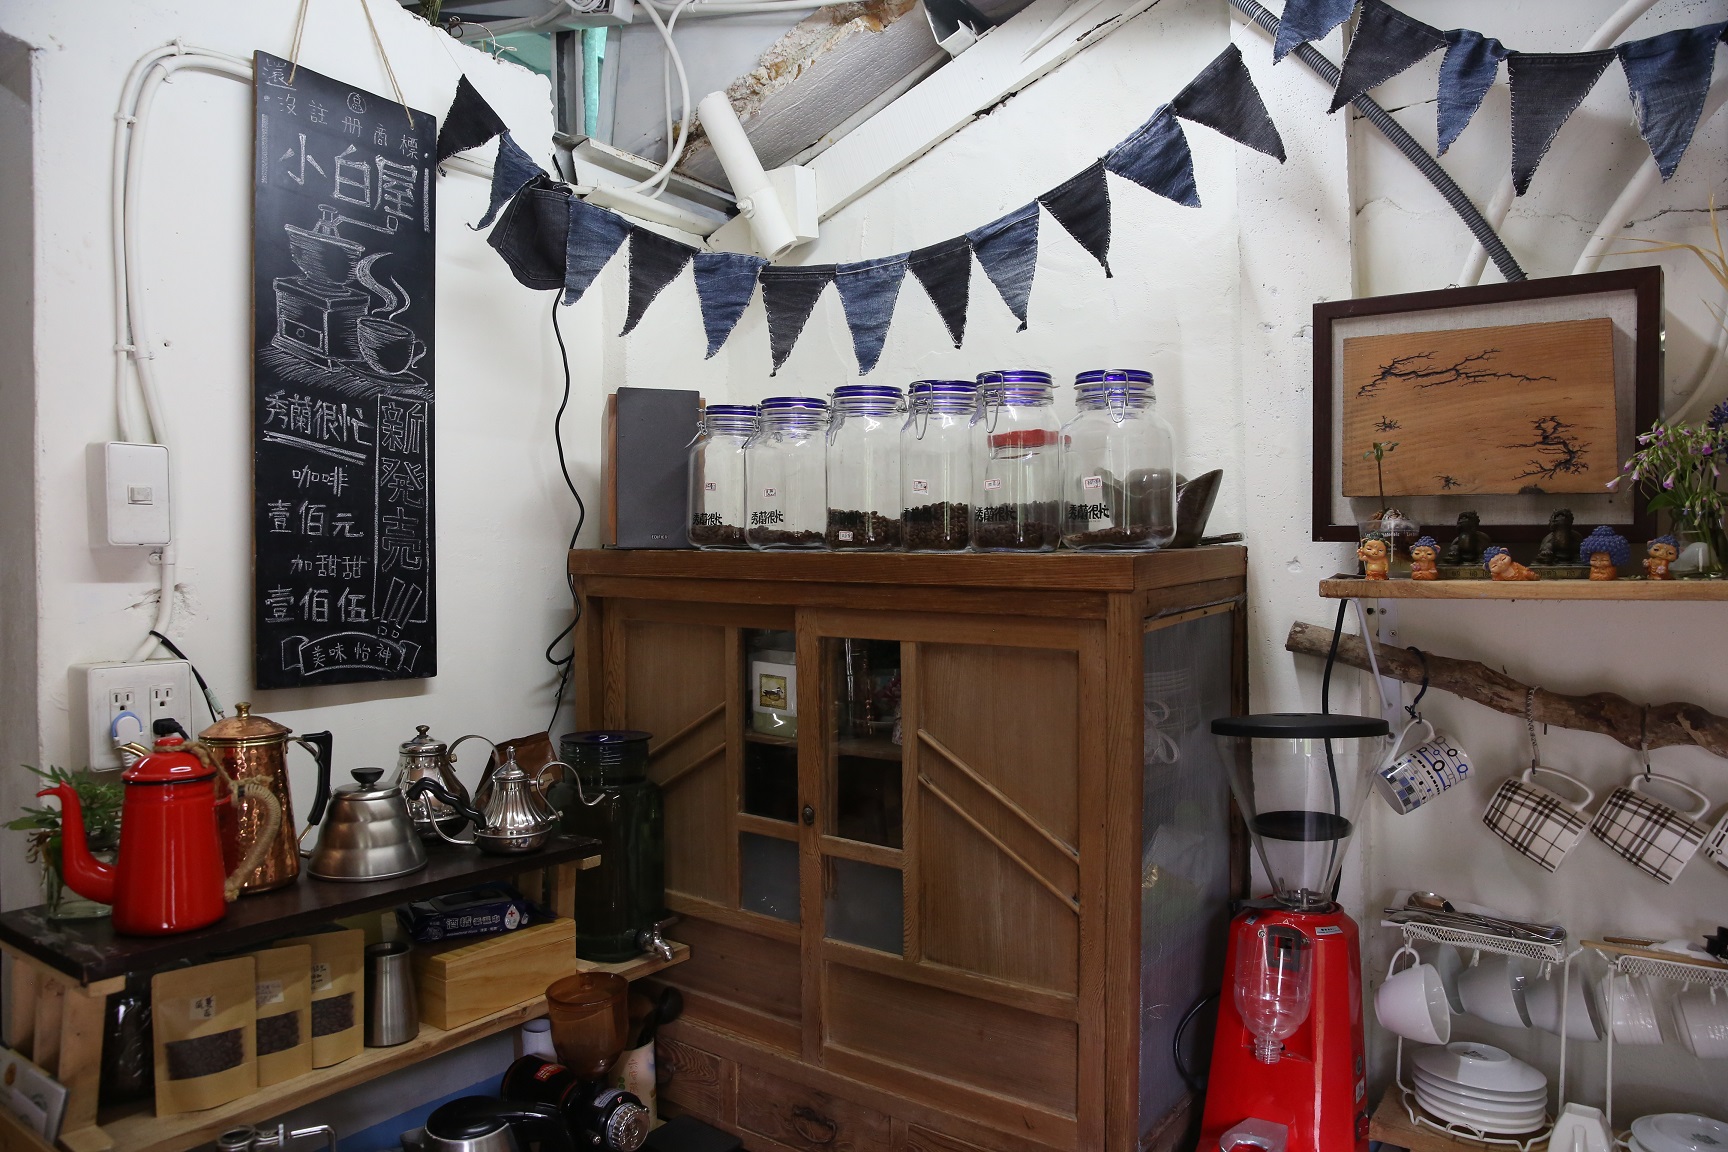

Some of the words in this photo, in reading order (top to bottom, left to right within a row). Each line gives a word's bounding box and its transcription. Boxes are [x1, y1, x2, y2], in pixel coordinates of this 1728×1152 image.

[279, 132, 419, 221] 小白屋
[263, 389, 375, 447] 秀蘭很忙
[292, 464, 350, 497] 咖啡
[267, 500, 365, 538] 壹佰元
[290, 554, 367, 580] 加甜甜
[265, 584, 370, 624] 壹佰伍
[312, 641, 393, 668] 美味怡神
